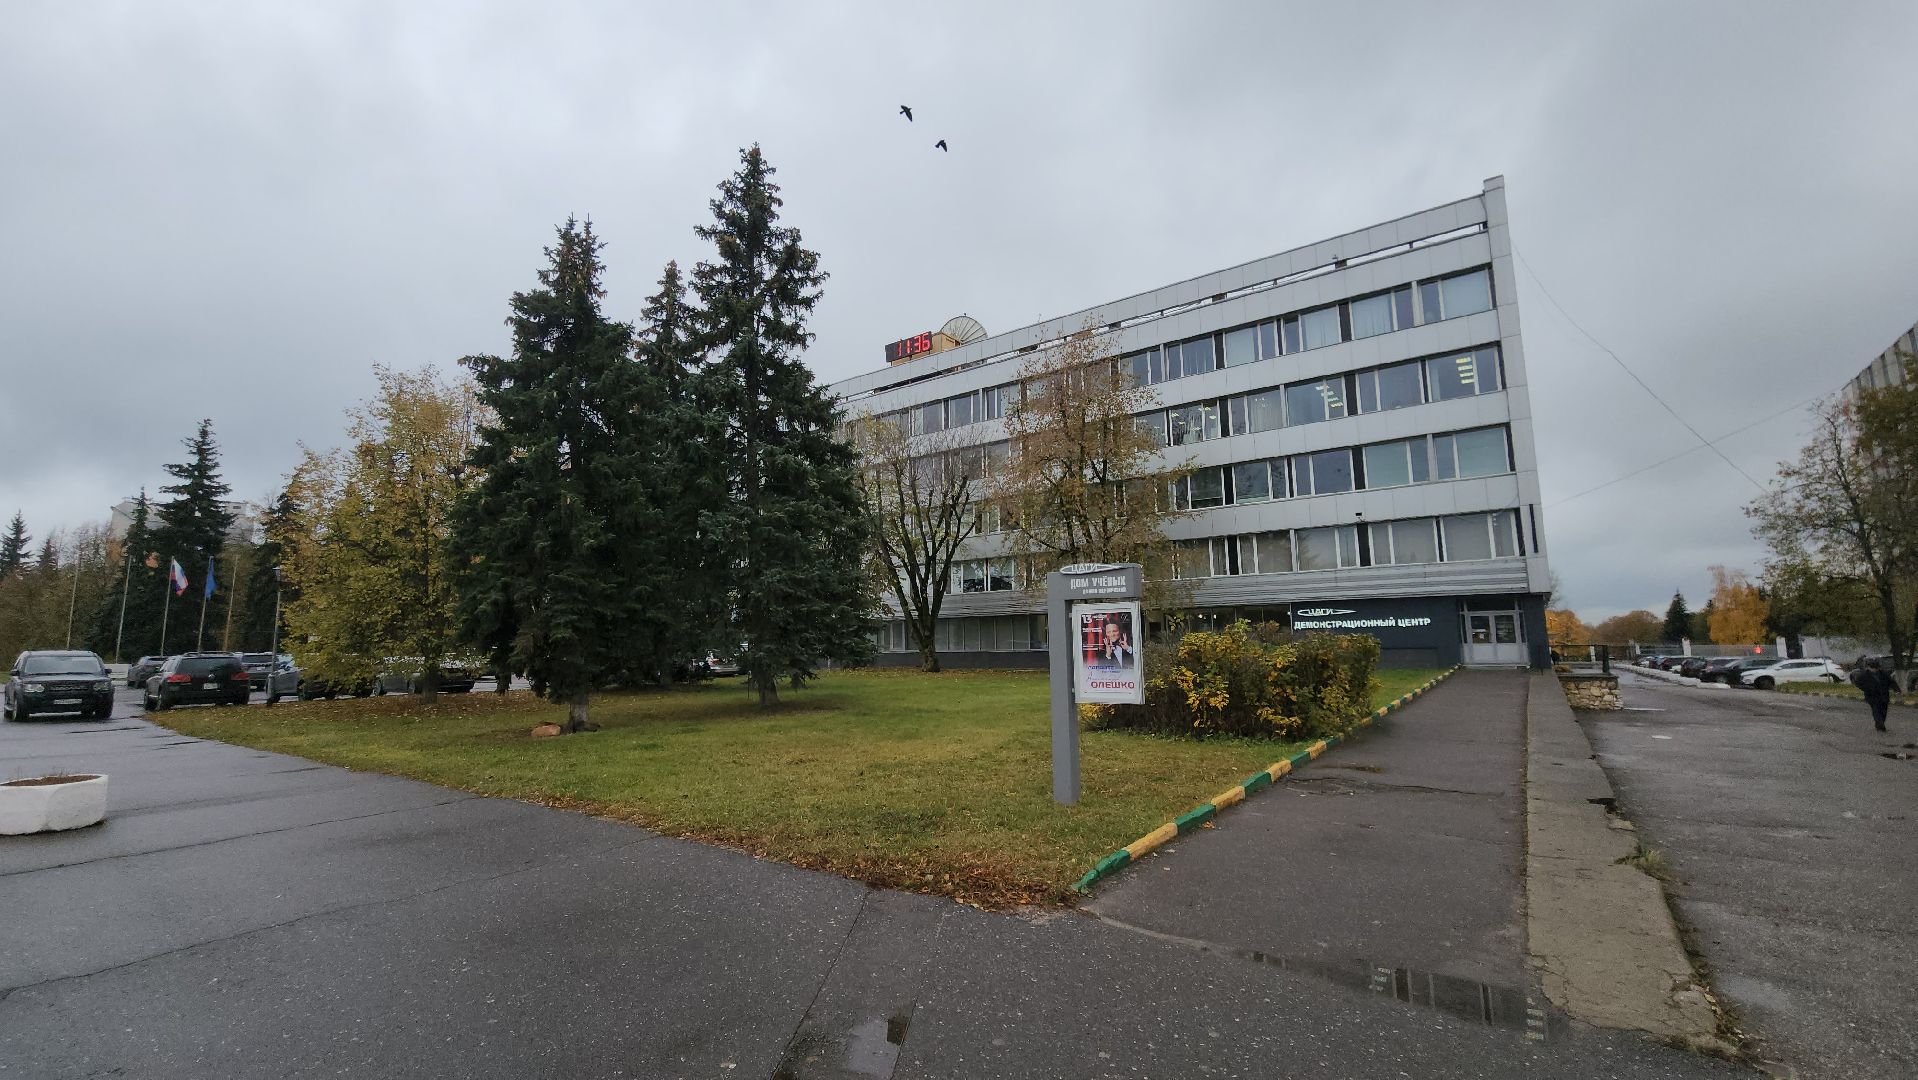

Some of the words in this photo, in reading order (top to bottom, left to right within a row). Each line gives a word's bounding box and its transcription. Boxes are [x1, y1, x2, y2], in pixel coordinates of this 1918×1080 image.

[1071, 579, 1089, 590] ДОМ
[1092, 576, 1126, 587] УЧЁНЫХ
[1308, 608, 1334, 617] ЦАГИ
[1081, 614, 1093, 623] 13
[1293, 617, 1396, 630] ДЕМОНСТРАЦИОННЫЙ
[1397, 618, 1431, 628] ЦЕНТР
[1091, 681, 1135, 689] ОЛЕШКО
